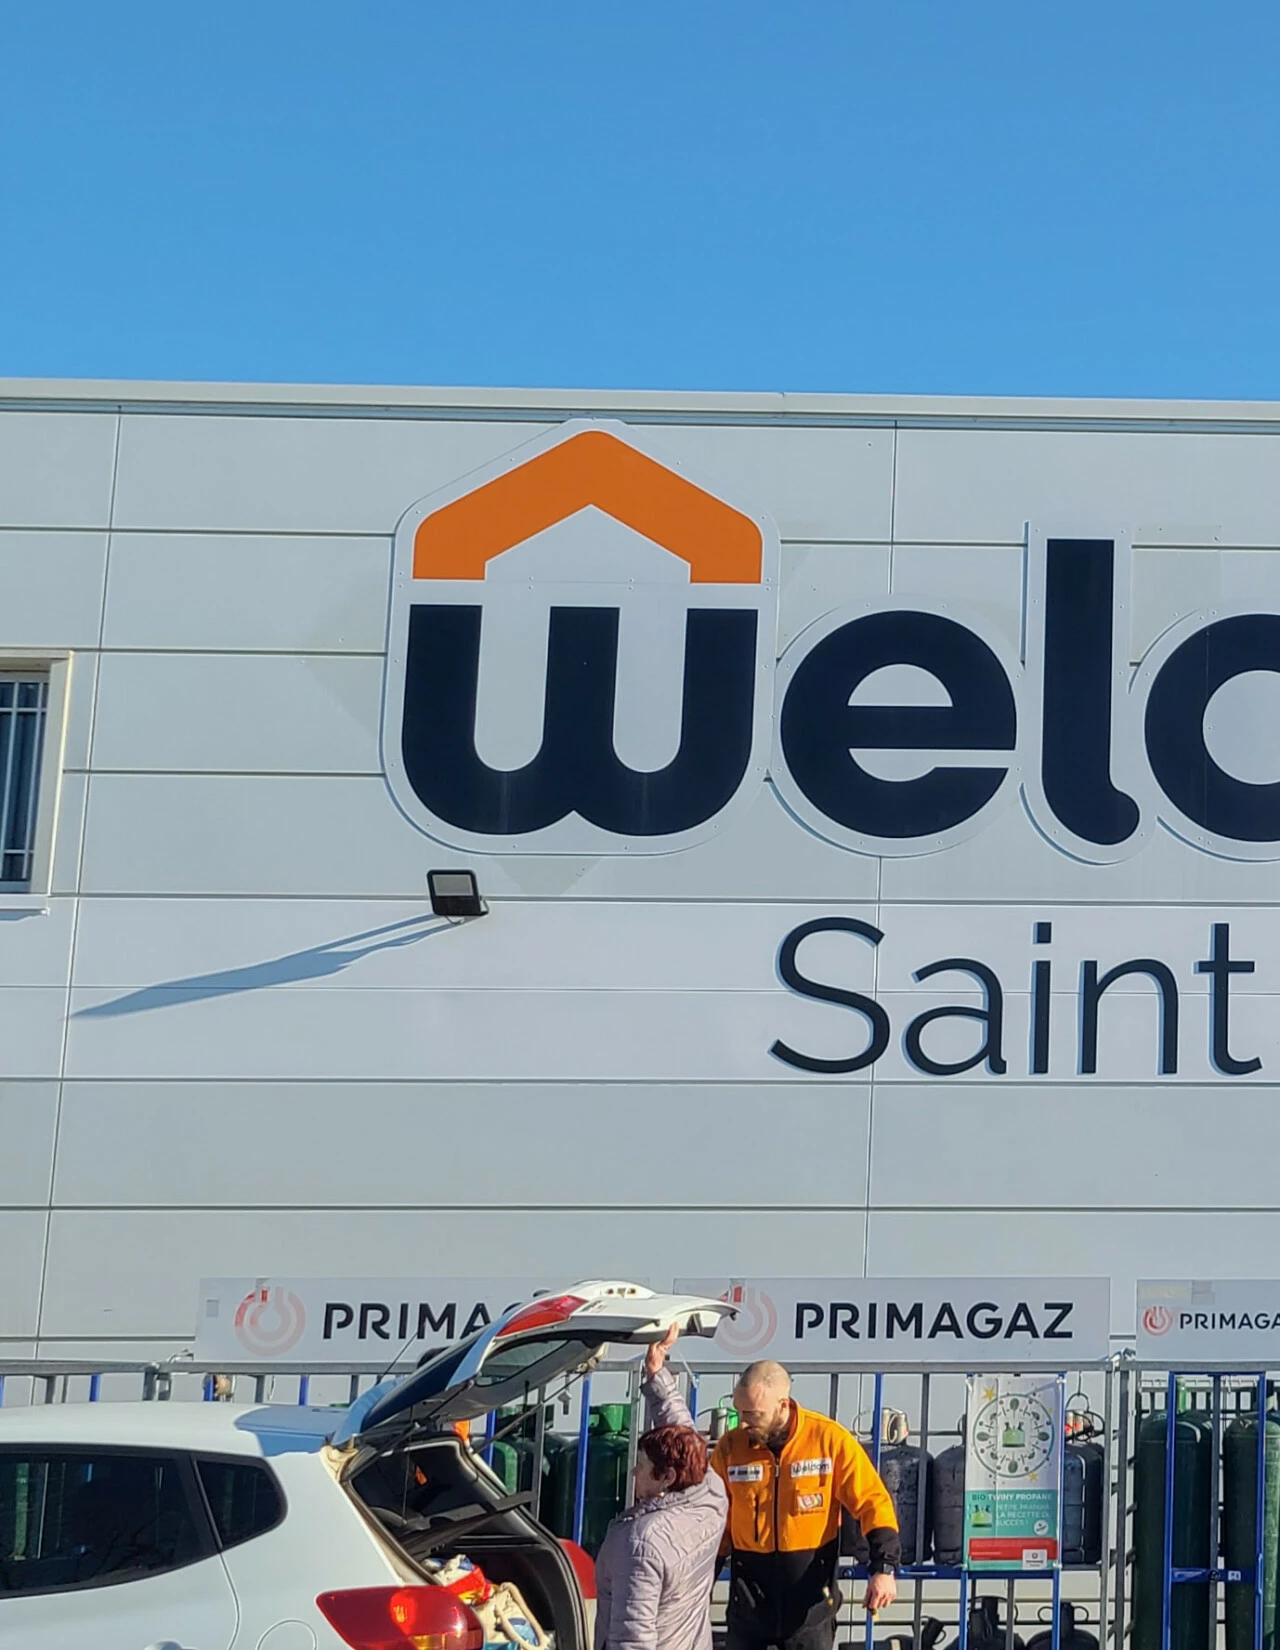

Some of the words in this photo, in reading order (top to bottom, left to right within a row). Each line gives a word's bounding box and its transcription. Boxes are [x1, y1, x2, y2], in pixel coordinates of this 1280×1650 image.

[768, 916, 1264, 1076] Saint
[322, 1301, 523, 1340] PRIMA
[794, 1301, 1075, 1340] PRIMAGAZ
[1015, 1493, 1052, 1501] PROPANE
